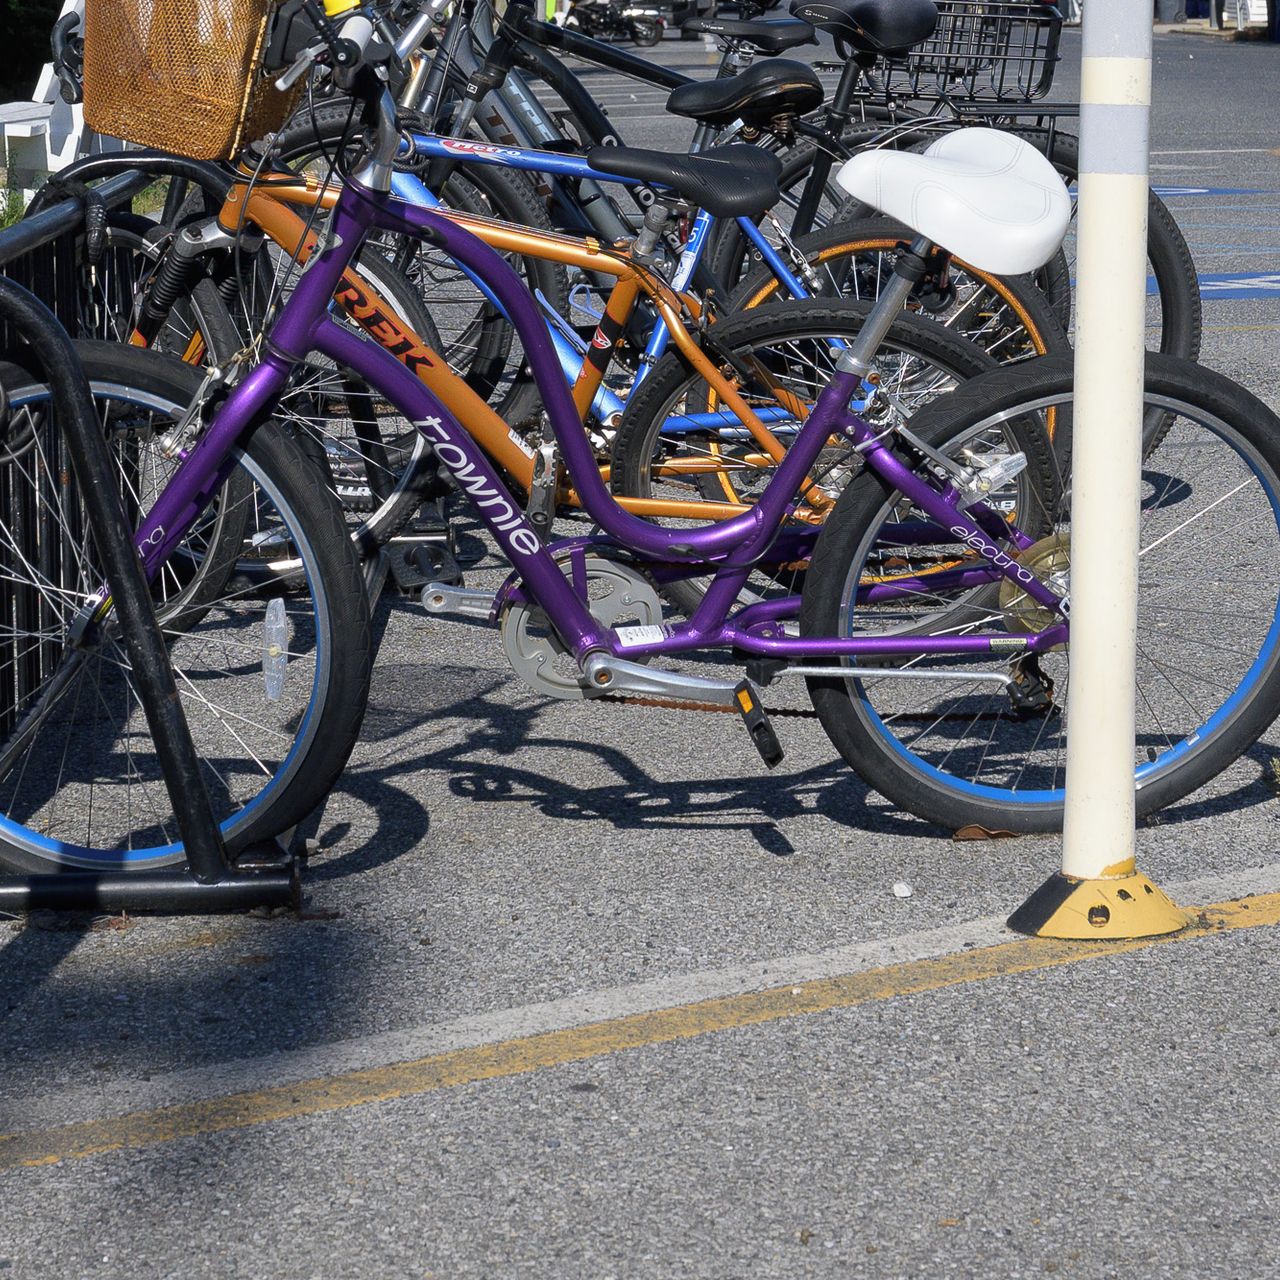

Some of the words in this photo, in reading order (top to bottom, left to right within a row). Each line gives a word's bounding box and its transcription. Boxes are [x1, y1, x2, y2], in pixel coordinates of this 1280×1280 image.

[334, 276, 434, 377] REK
[415, 415, 540, 556] townie
[950, 525, 1034, 583] electra
